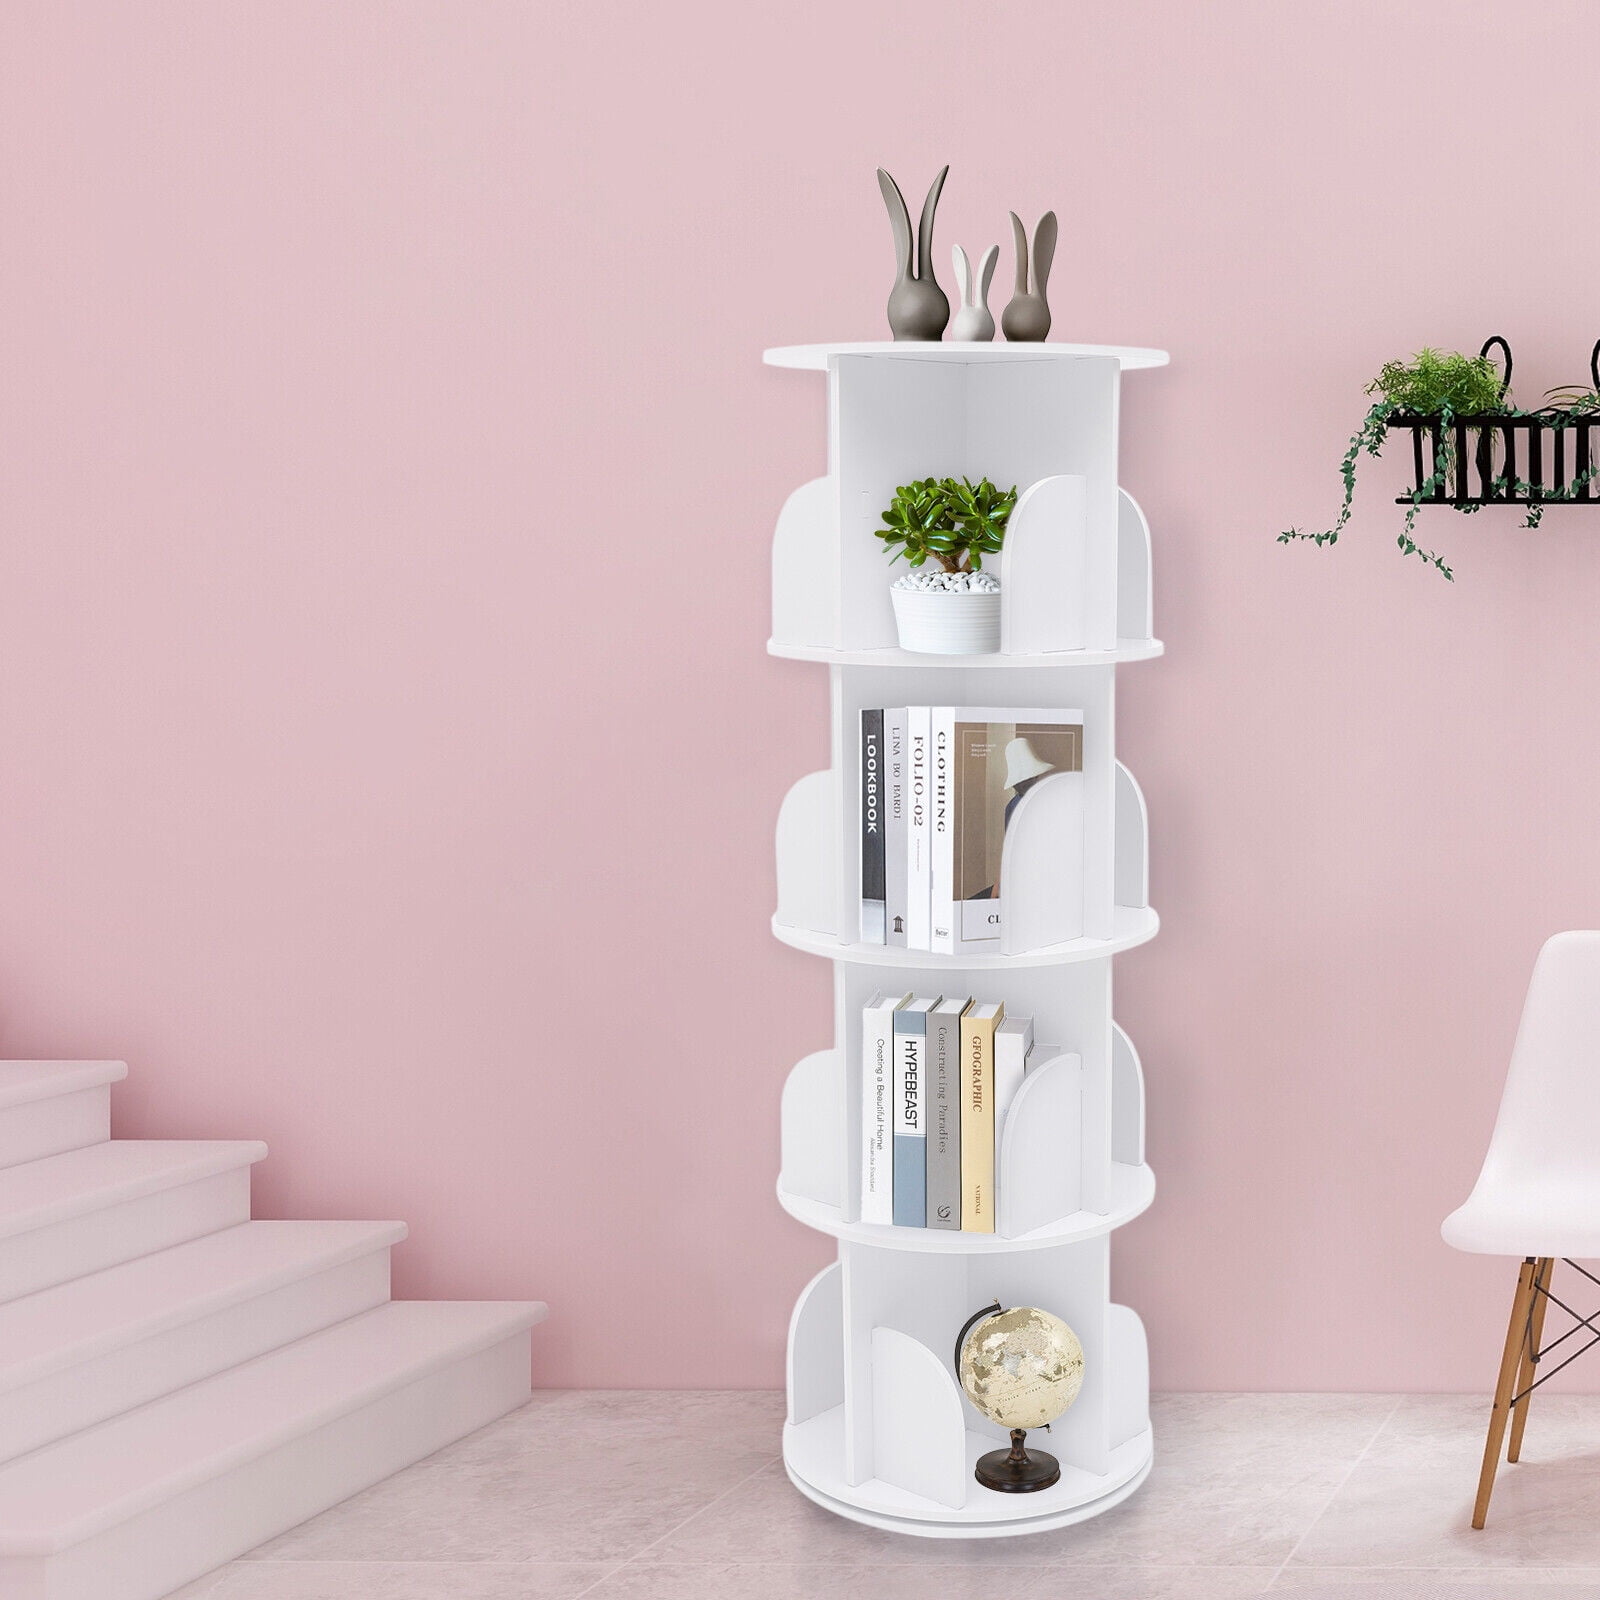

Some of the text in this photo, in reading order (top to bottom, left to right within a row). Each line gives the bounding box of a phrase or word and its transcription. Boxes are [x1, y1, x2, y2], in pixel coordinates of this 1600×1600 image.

[867, 735, 878, 833] LOOKBOOK
[892, 727, 901, 819] LINA BO BARDI
[914, 736, 924, 826] FOLIO-02
[937, 731, 946, 832] CLOTHING
[875, 1038, 885, 1151] Creating a Beautiful Home
[905, 1040, 918, 1129] HYPEBEAST
[938, 1027, 948, 1154] Constructing Paradies
